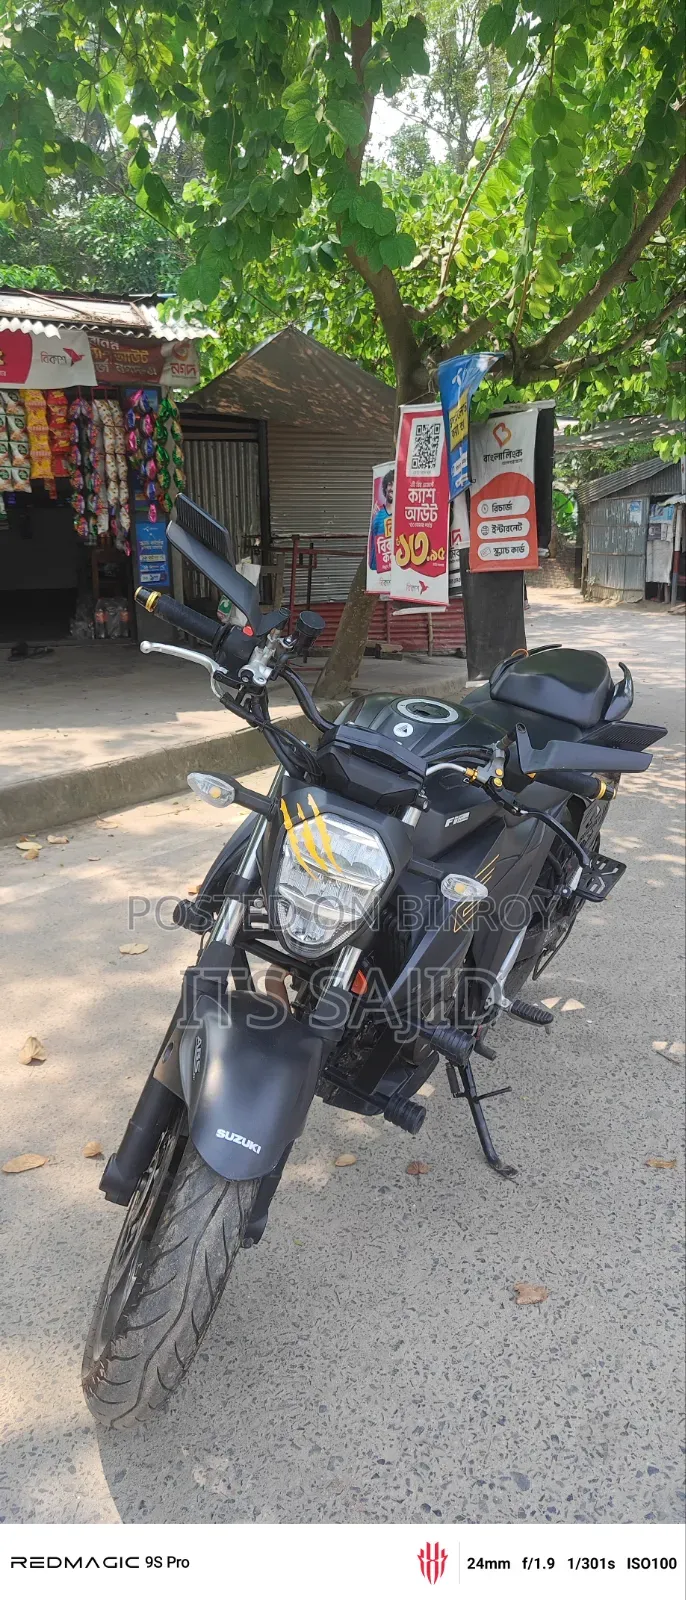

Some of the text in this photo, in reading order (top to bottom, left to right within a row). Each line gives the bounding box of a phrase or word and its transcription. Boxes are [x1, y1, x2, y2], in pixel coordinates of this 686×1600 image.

[40, 350, 68, 365] বিকাশ
[483, 448, 523, 463] বাংলালিংক
[407, 488, 437, 504] ক্যাশ
[404, 503, 439, 522] আউট
[491, 500, 513, 513] রিচার্জ
[491, 522, 523, 535] ইন্টারনেট
[510, 542, 525, 555] কার্ড
[215, 1128, 262, 1155] SUZUKI
